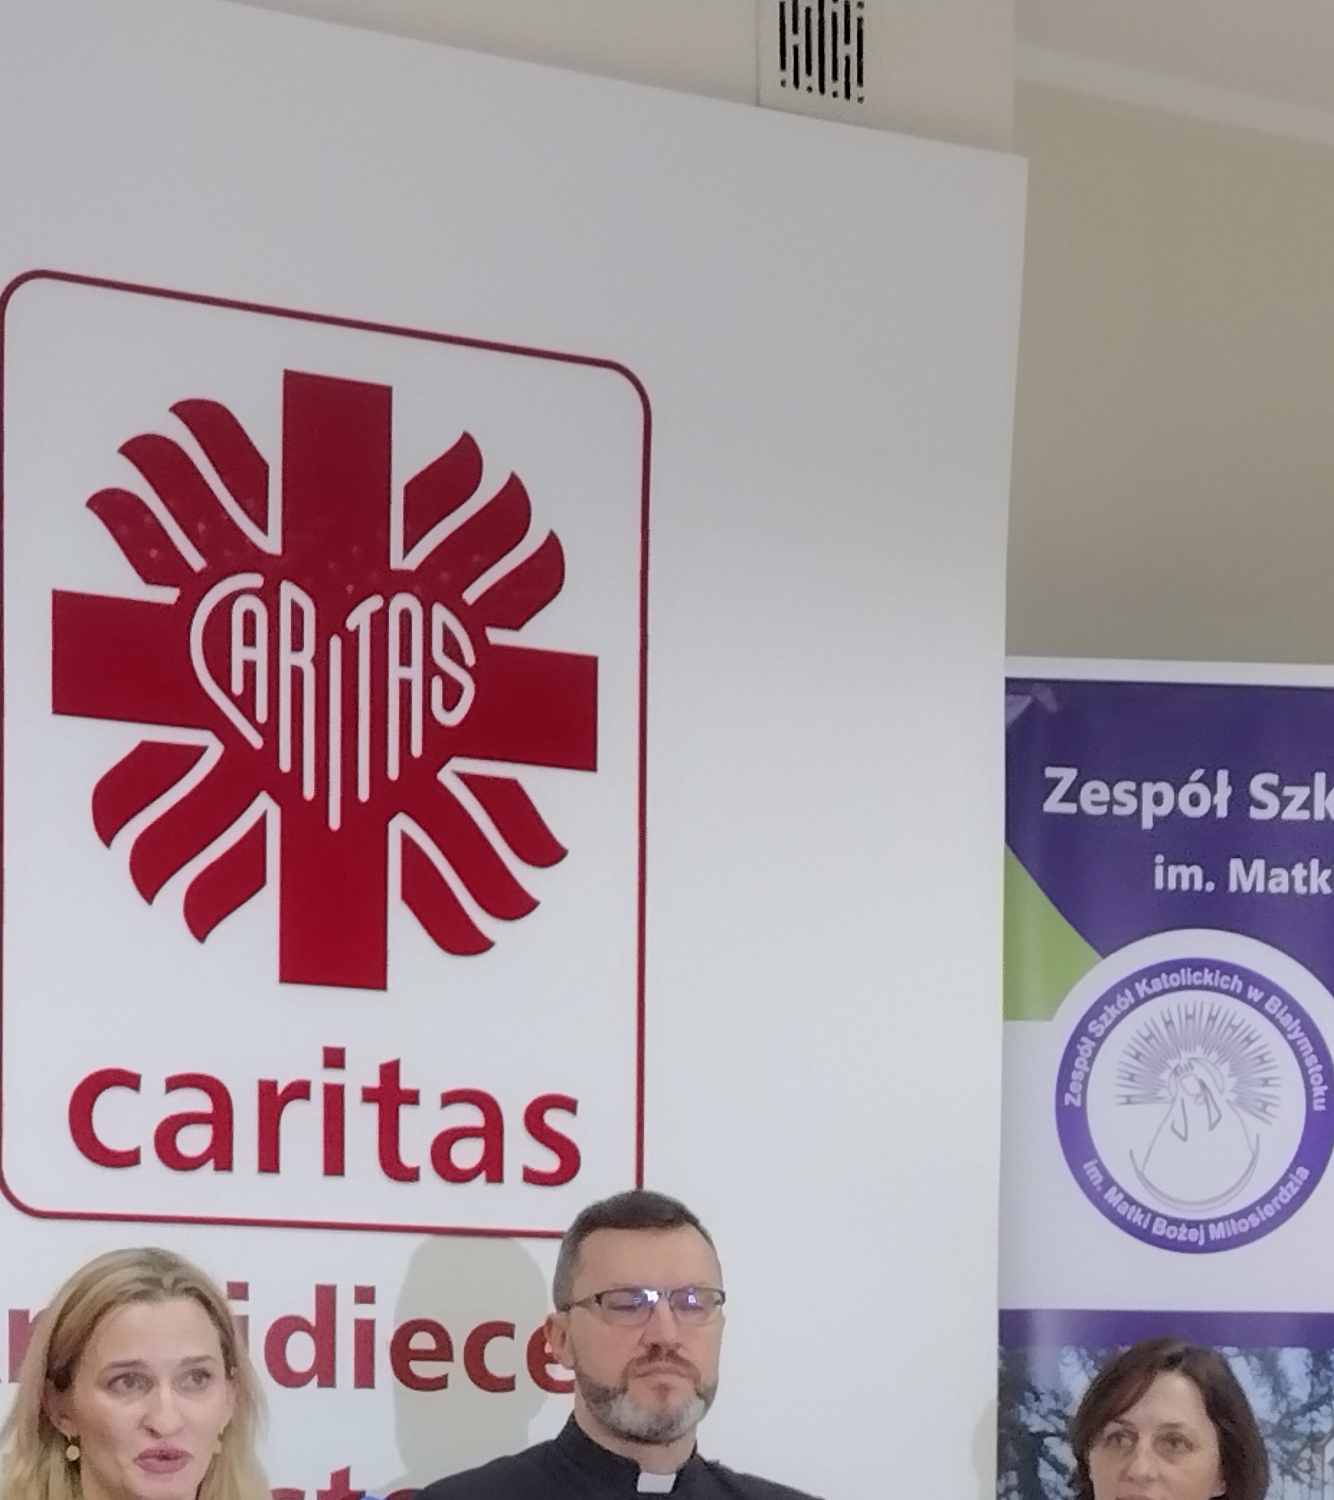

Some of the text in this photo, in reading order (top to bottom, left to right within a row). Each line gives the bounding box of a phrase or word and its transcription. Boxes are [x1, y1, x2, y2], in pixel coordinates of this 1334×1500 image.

[190, 573, 475, 831] CARITAS
[1043, 766, 1232, 829] Zespół
[1153, 855, 1216, 892] im.
[1134, 967, 1243, 998] Katolickich
[68, 1046, 581, 1189] caritas
[1103, 1185, 1150, 1230] Matki
